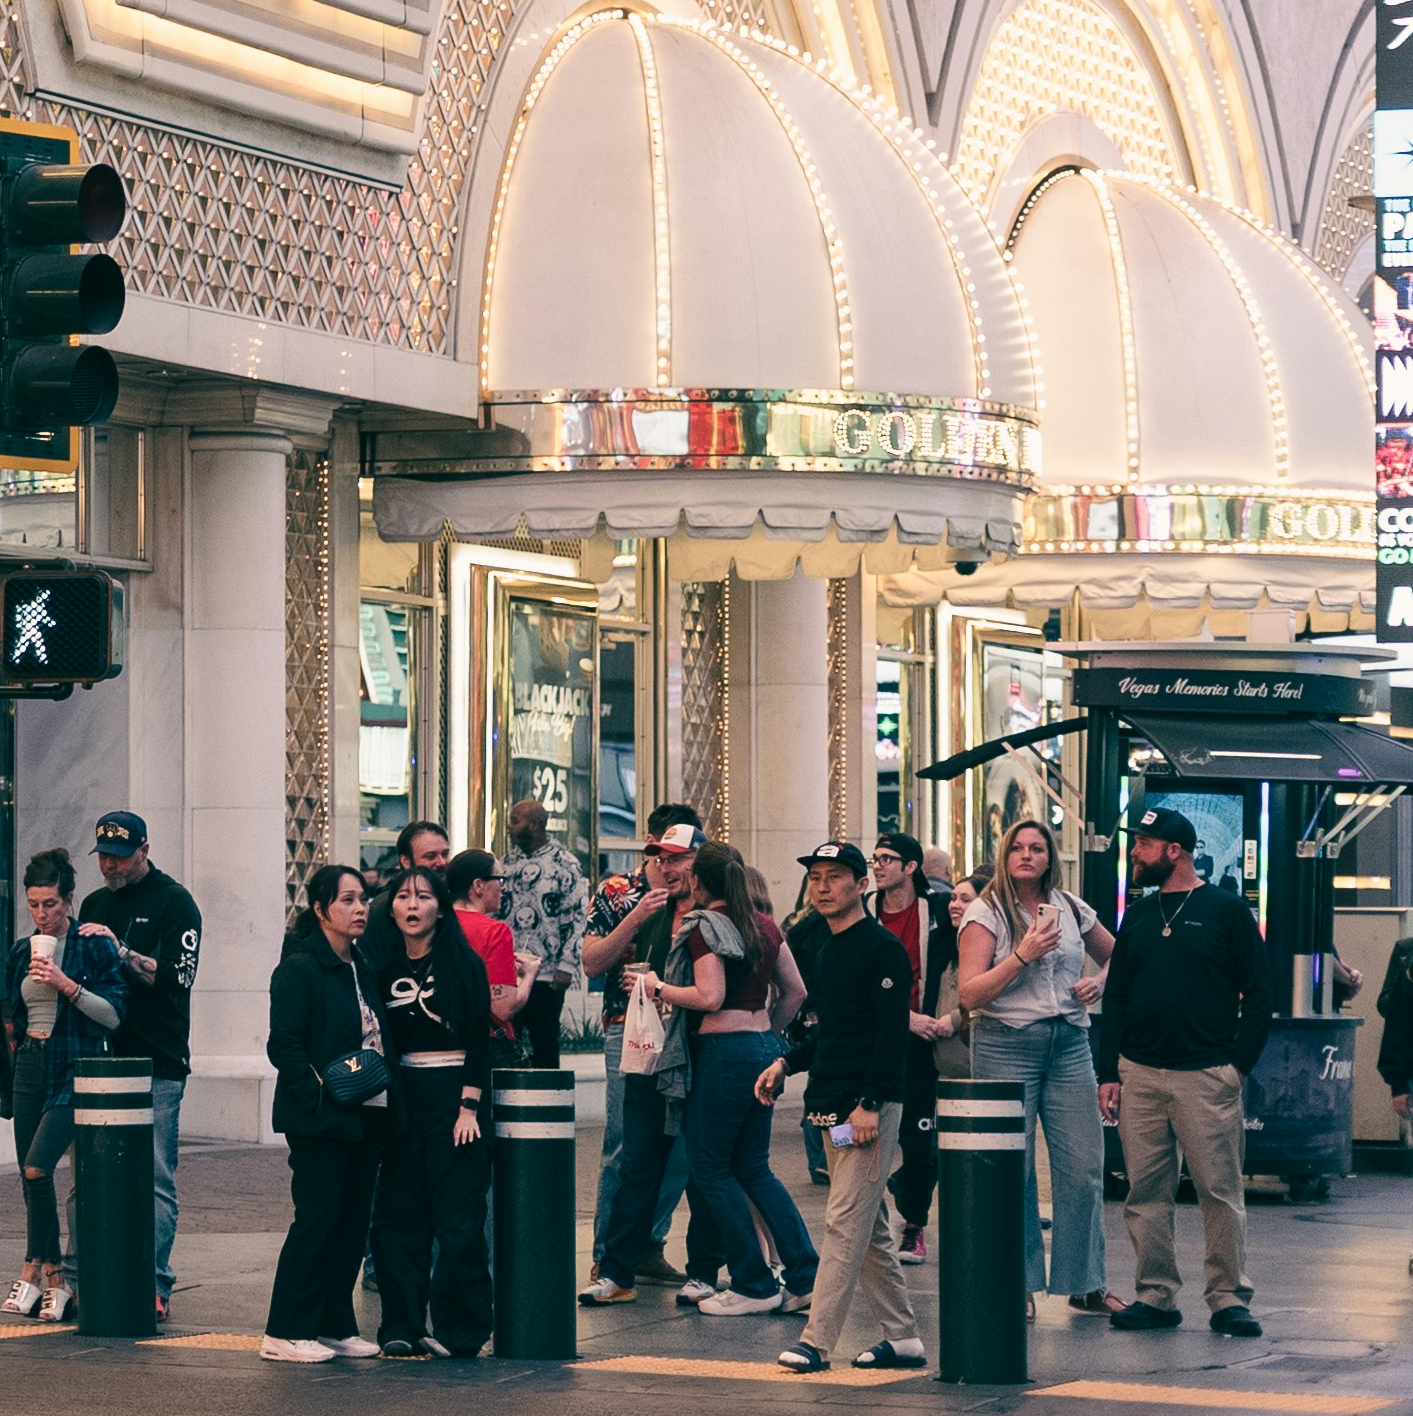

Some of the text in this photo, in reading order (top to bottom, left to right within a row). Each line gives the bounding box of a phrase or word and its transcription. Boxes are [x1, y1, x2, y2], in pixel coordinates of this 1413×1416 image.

[515, 682, 590, 716] BLACKJACK
[1118, 677, 1160, 699] Vegas
[1166, 678, 1229, 695] Memories
[1233, 679, 1269, 698] Starts
[533, 766, 568, 814] $25
